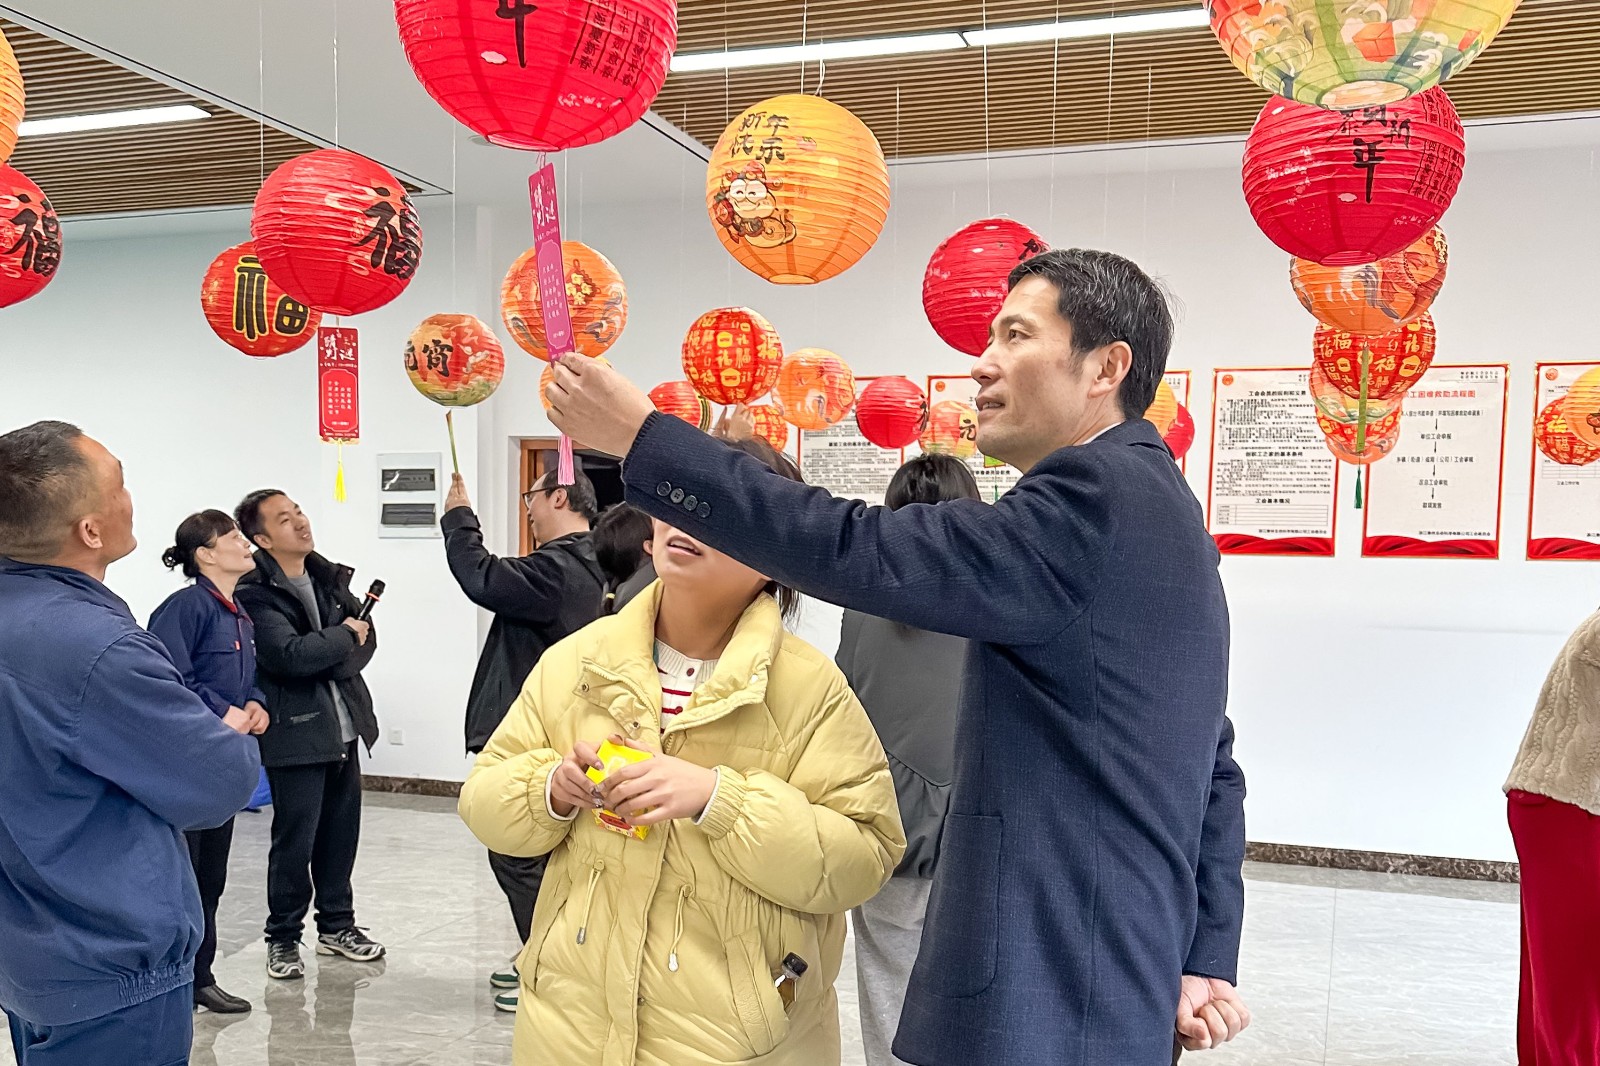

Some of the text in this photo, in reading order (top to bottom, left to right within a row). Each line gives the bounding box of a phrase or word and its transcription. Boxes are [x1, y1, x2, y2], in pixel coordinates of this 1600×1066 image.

[730, 134, 785, 164] 快乐
[738, 111, 789, 136] 新年
[3, 193, 60, 277] 福
[355, 186, 421, 280] 福
